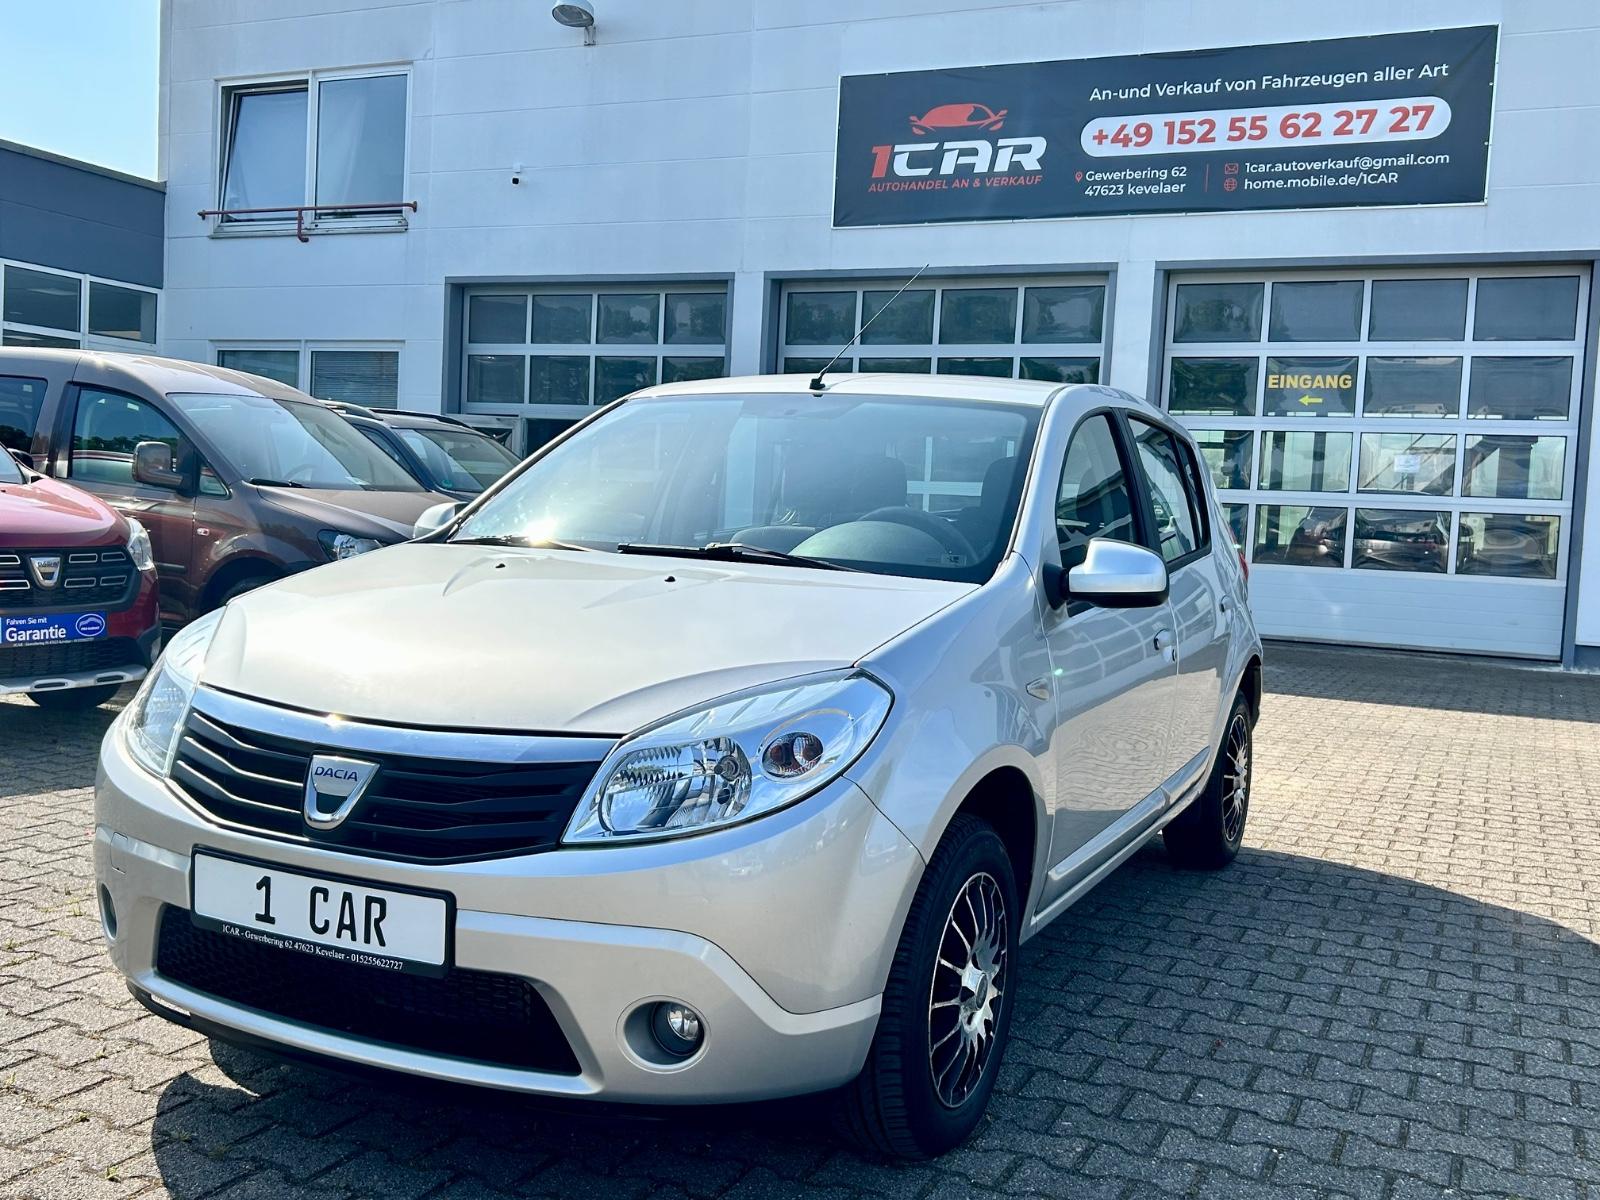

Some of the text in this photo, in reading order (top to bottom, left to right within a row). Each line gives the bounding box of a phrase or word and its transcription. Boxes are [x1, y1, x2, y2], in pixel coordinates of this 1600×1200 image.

[1089, 63, 1449, 101] An-und Verkauf von Fahrzeugen aller Art
[1092, 104, 1435, 148] +49 152 55 62 27 27
[871, 136, 1047, 178] 1CAR
[1245, 153, 1450, 173] 1car.autoverkauf@gmail.com
[1085, 166, 1187, 182] Gewerbering 62
[1244, 172, 1399, 190] home.mobile.de/1CAR
[868, 175, 1043, 193] AUTOHANDEL AN & VERKAUF
[1084, 182, 1186, 197] 47623 kevelaer
[1267, 374, 1352, 390] EINGANG
[6, 618, 27, 626] Fahren
[27, 617, 37, 625] Sie
[6, 625, 66, 641] Garantie
[314, 766, 358, 782] DACIA
[255, 875, 387, 947] 1 CAR
[244, 930, 284, 949] Gewerbering
[284, 940, 293, 949] 62
[294, 942, 314, 953] 47623
[315, 946, 345, 961] Kevelaer
[351, 953, 403, 971] 015255622727
